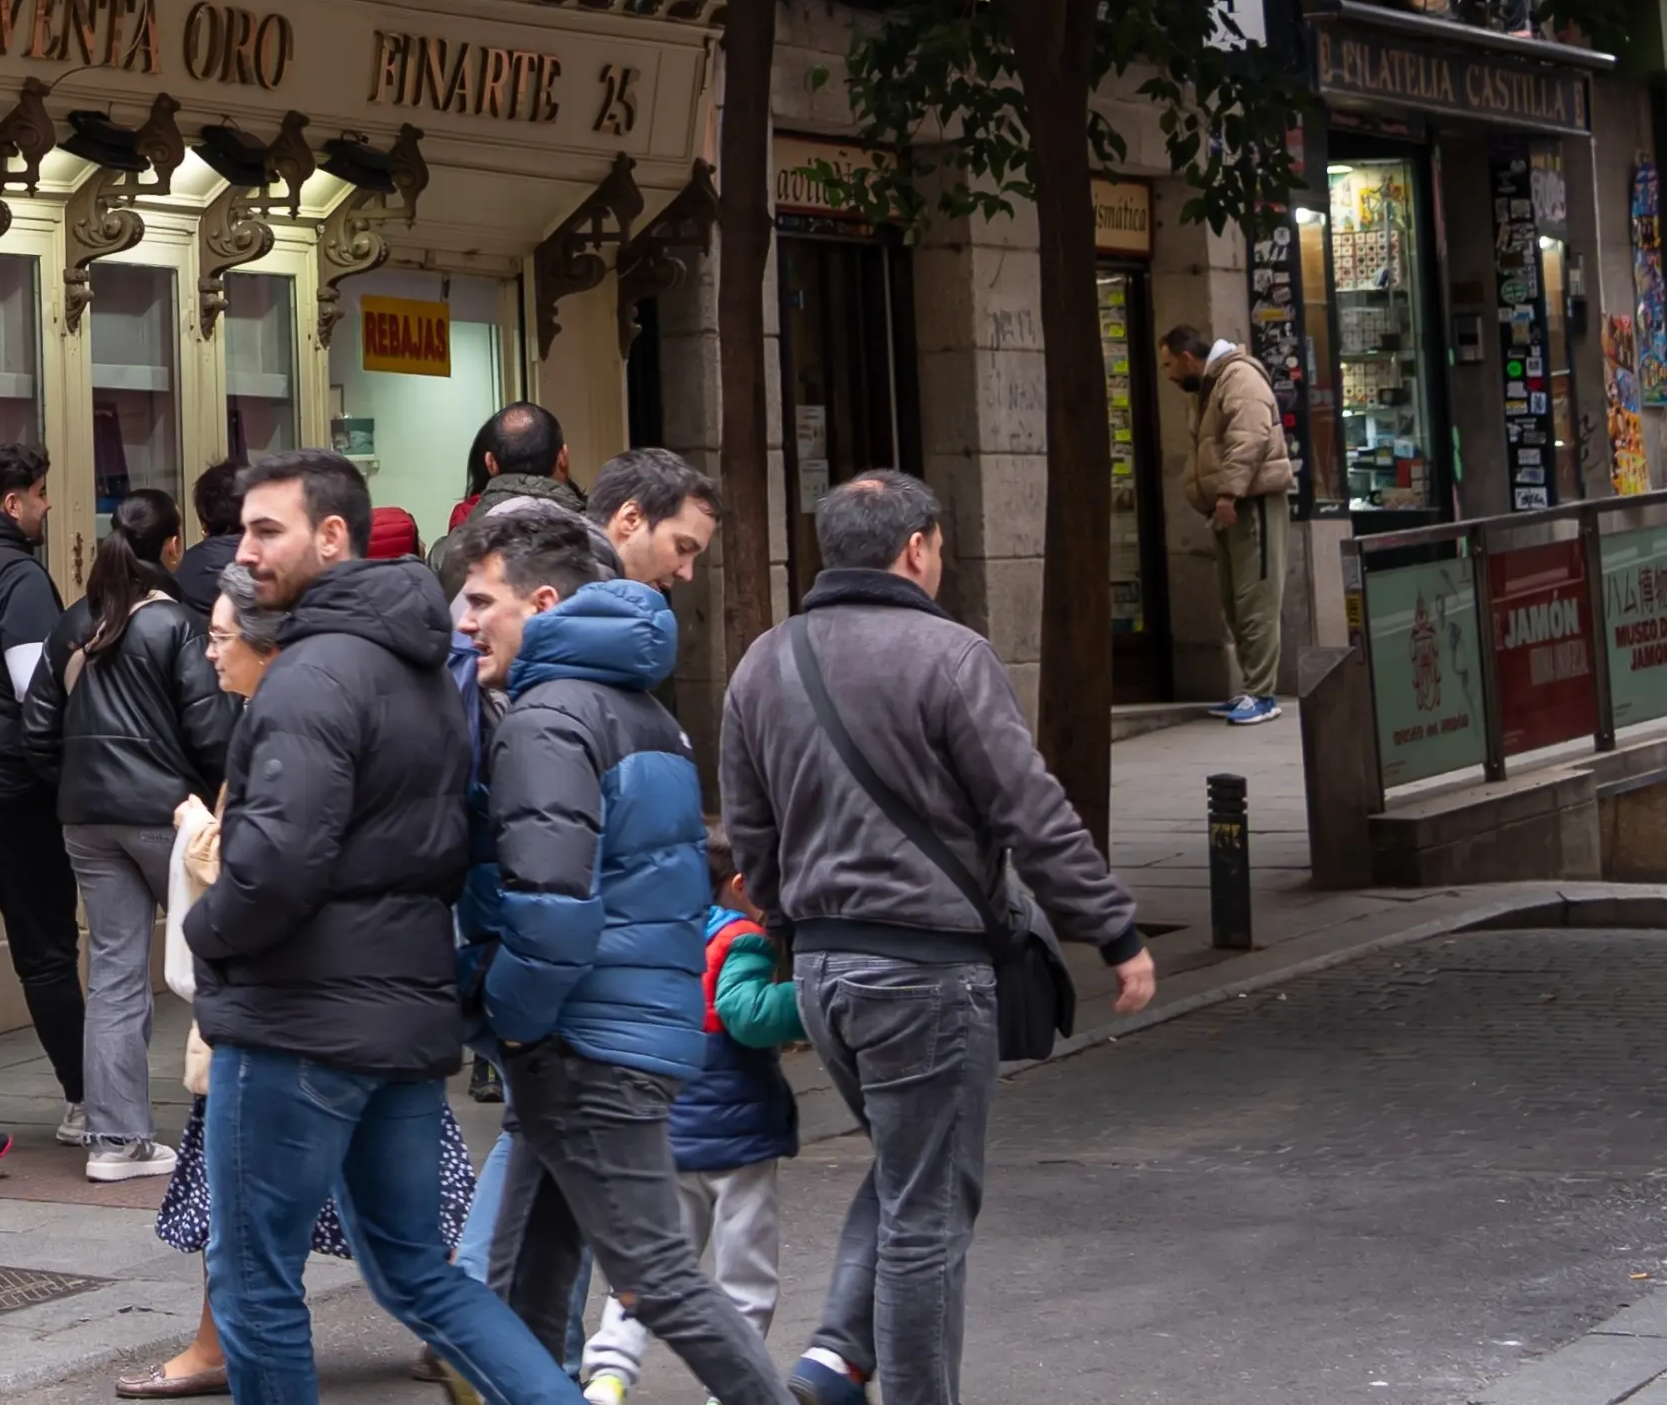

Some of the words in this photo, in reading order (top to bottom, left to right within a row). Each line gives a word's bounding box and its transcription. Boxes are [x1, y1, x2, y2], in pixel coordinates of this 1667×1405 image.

[183, 1, 294, 91] ORO
[367, 29, 562, 124] FINARTE
[593, 63, 642, 137] 25
[1342, 40, 1455, 103] FILATELIA
[1465, 63, 1567, 122] CASTILLA
[363, 309, 448, 364] REBAJAS
[1505, 589, 1581, 650] JAMÓN
